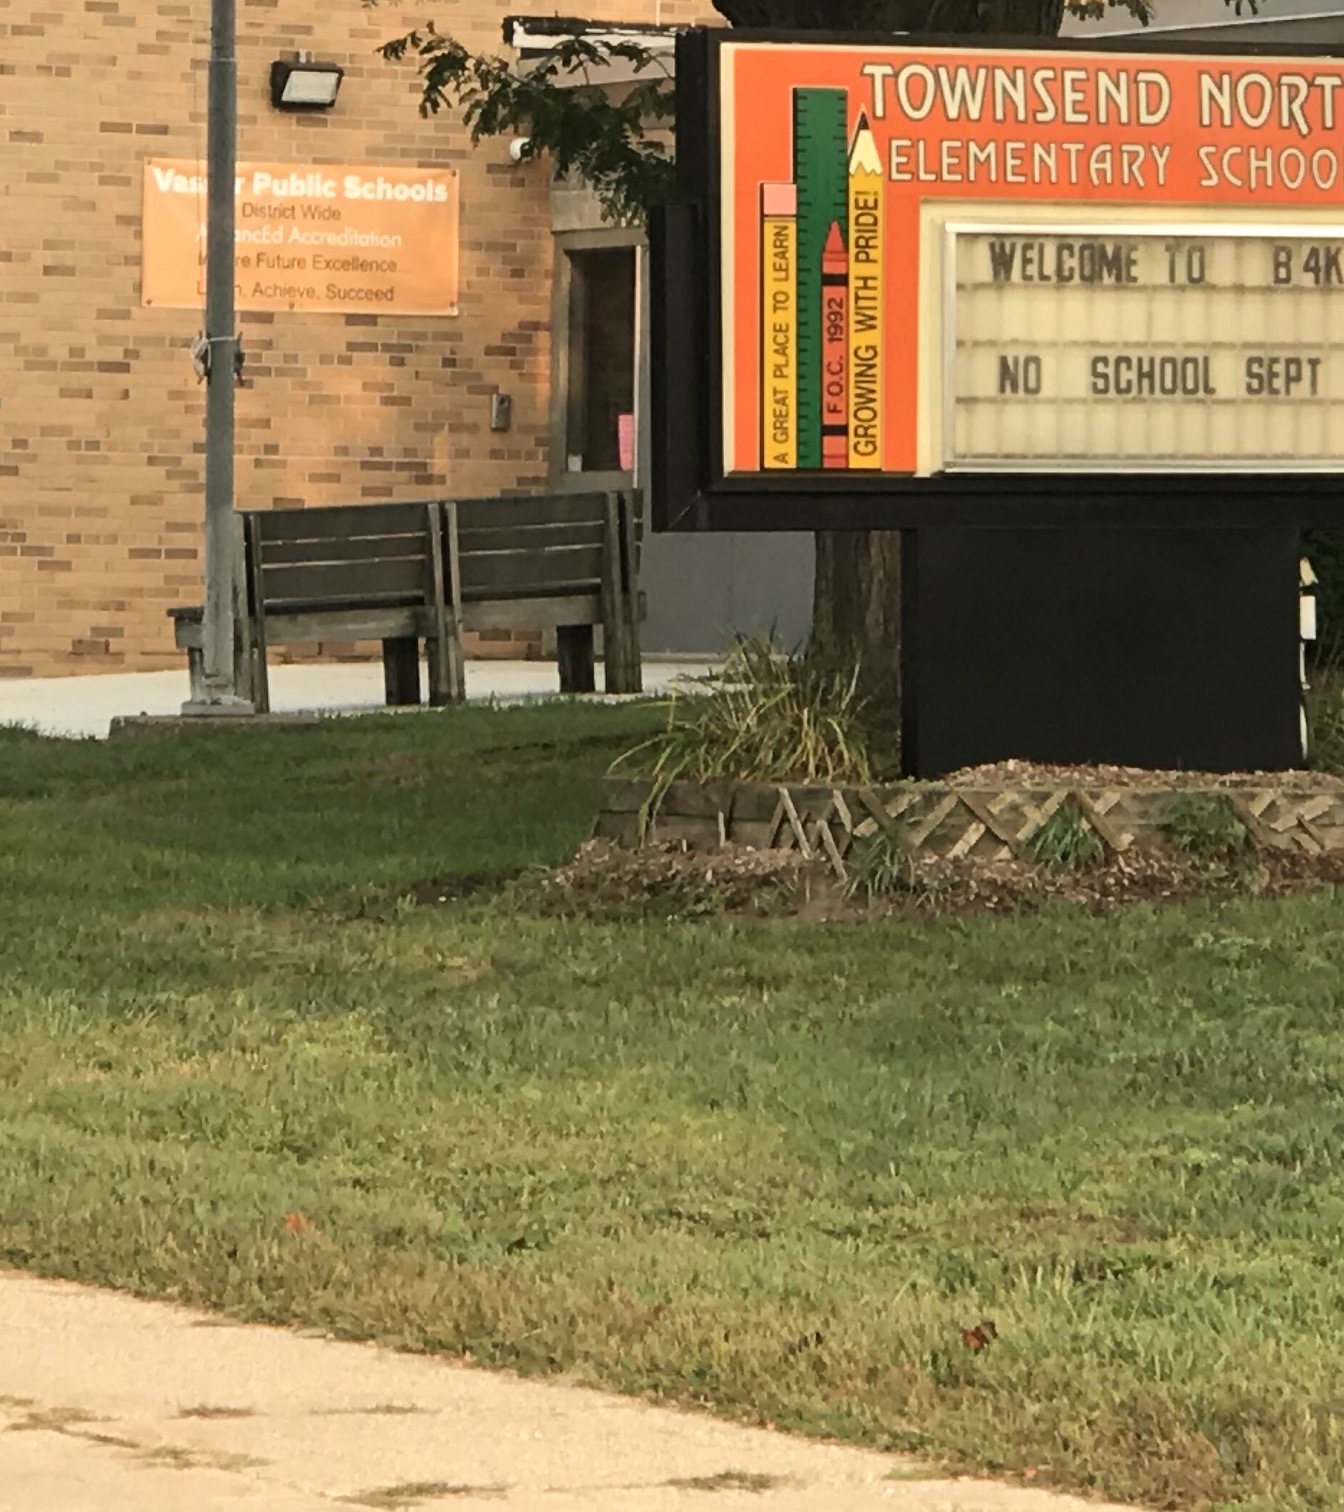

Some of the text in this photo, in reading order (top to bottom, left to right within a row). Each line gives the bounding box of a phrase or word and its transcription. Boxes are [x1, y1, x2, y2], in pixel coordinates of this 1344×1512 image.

[861, 62, 1171, 126] TOWNSEND
[888, 137, 1171, 188] ELEMENTARY
[152, 168, 448, 202] Vasr Public Schools
[242, 202, 341, 221] District Wide
[288, 225, 402, 248] Accreditation
[256, 252, 306, 269] Future
[989, 241, 1139, 283] WELCOME
[1164, 244, 1205, 284] TO
[326, 283, 394, 302] Succeed
[826, 297, 844, 344] 1992
[853, 190, 879, 457] GROWING WITH PRIDE!
[772, 225, 790, 464] A GREAT PLACE TO LEARN
[998, 354, 1042, 395] NO
[1091, 355, 1216, 396] SCHOOL
[1245, 356, 1321, 396] SEPT
